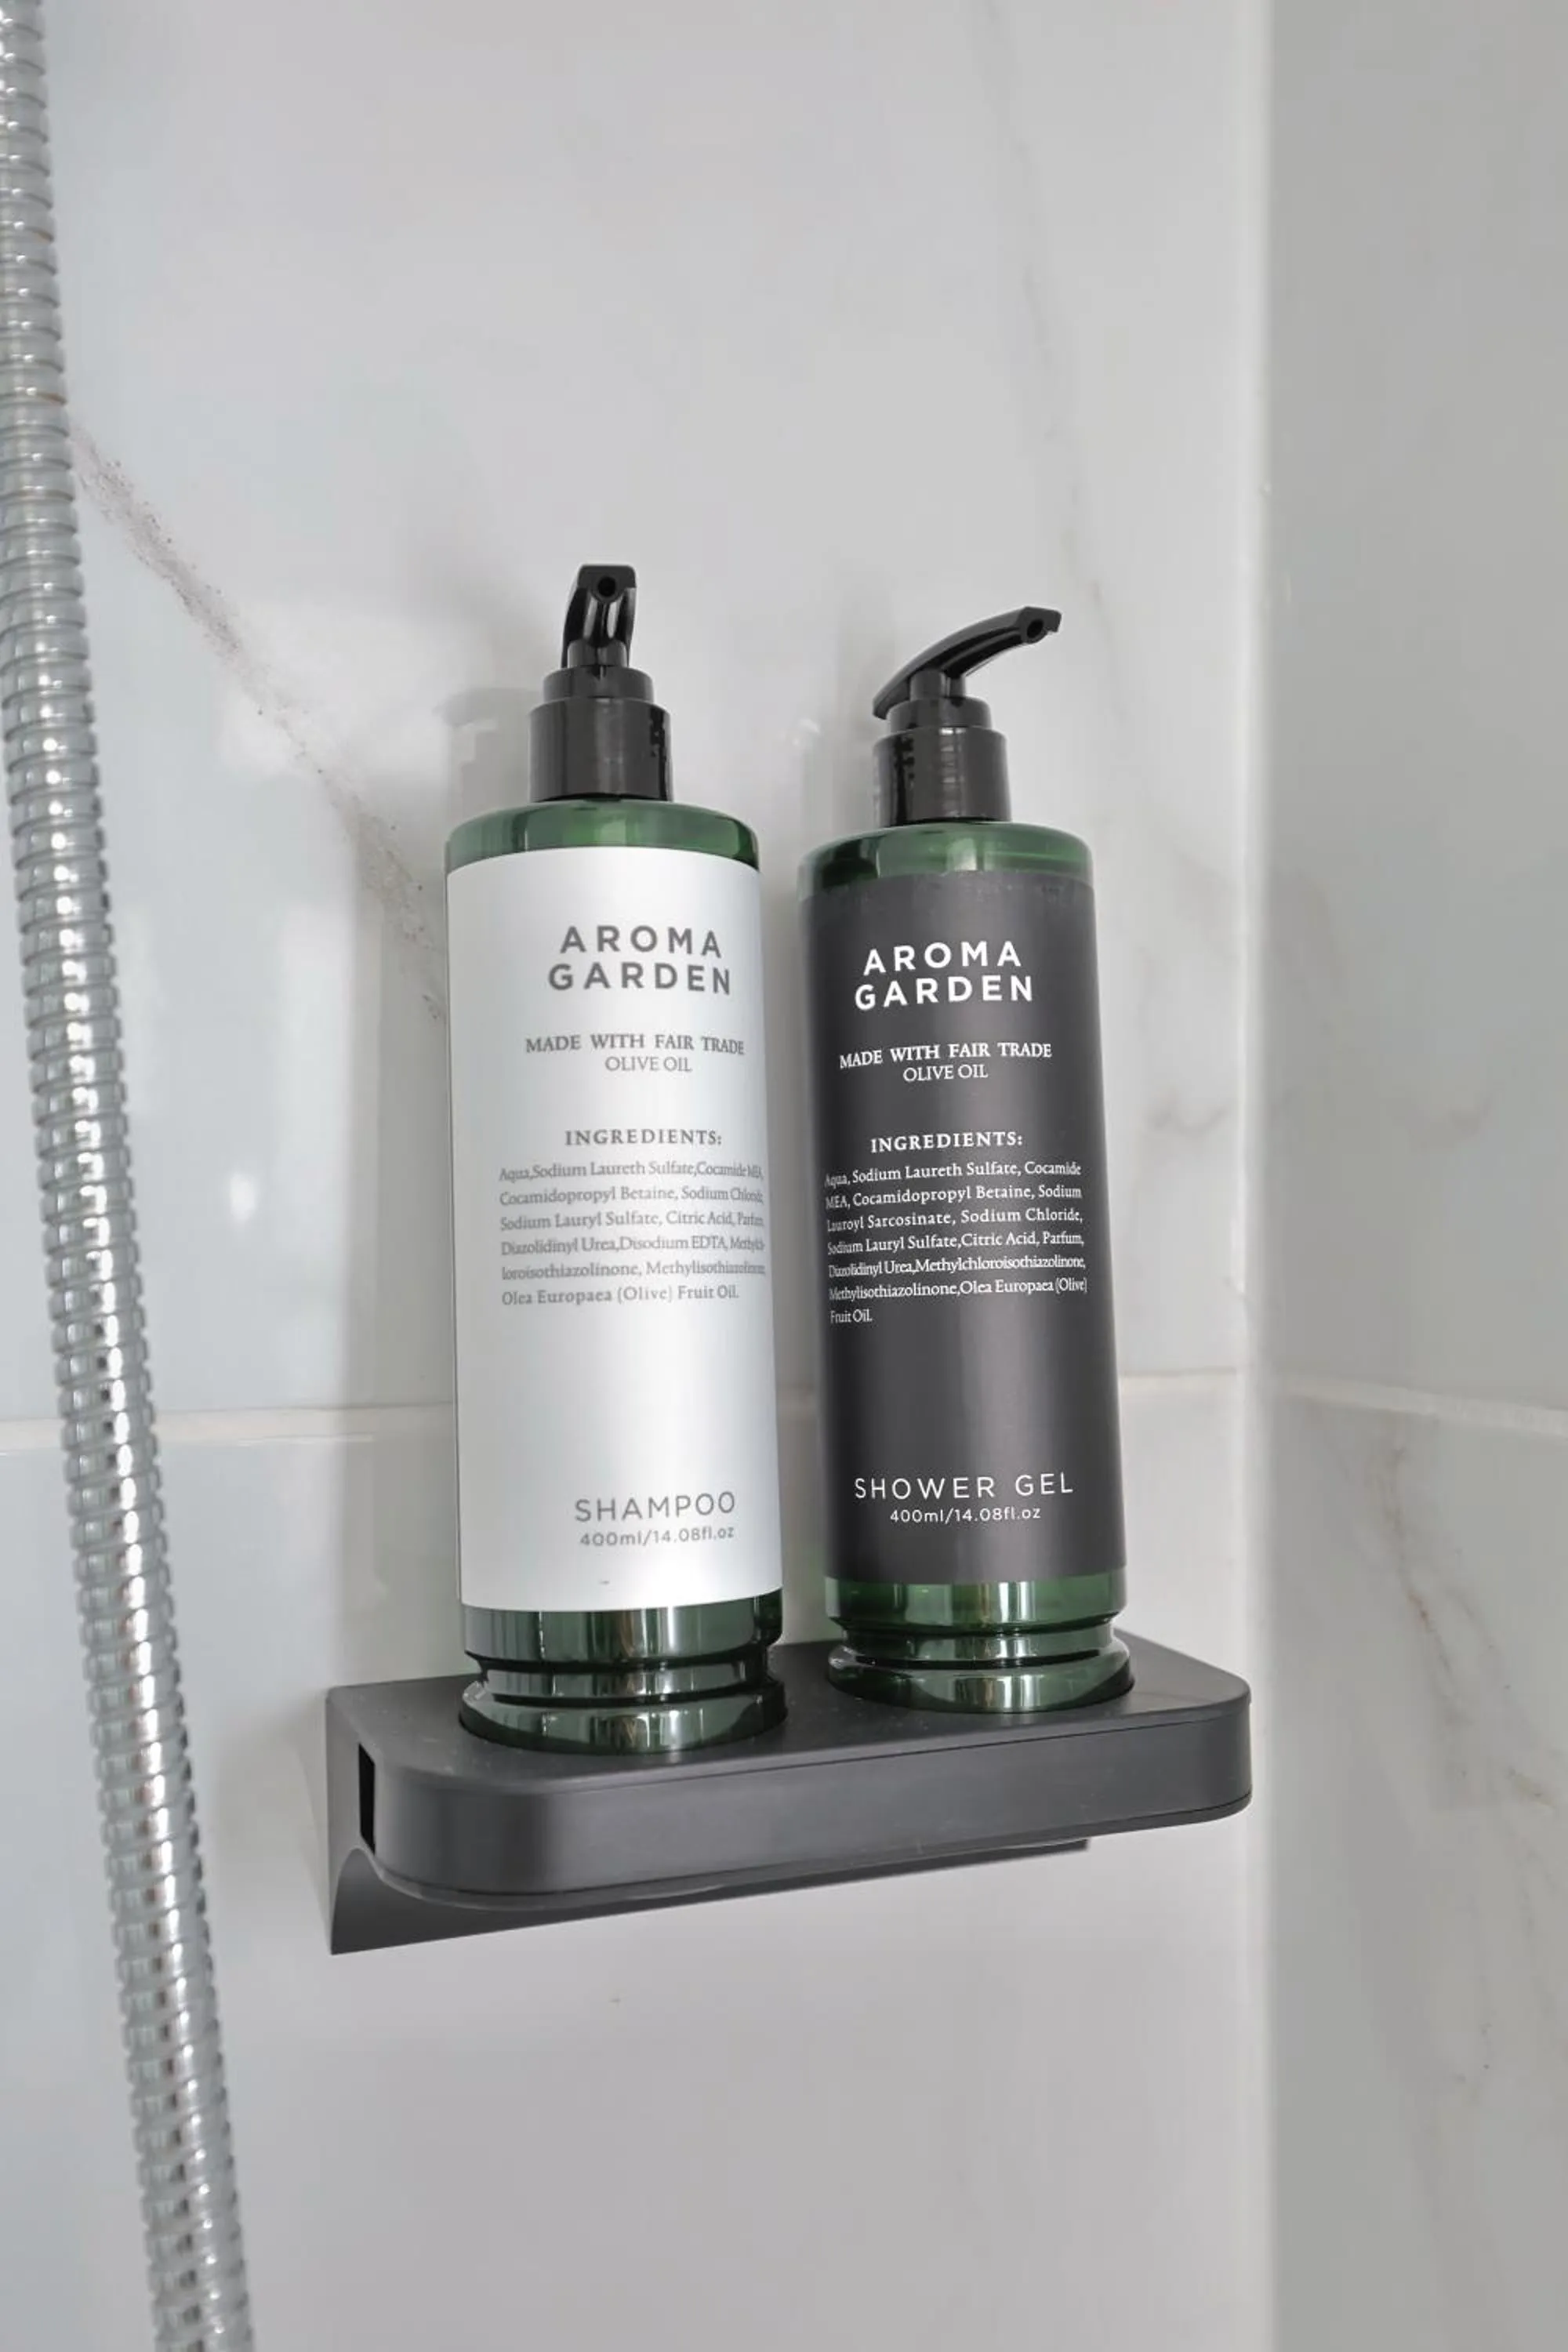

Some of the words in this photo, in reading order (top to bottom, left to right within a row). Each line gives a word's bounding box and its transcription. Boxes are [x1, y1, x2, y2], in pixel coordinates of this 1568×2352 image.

[560, 925, 721, 959] AROMA
[863, 941, 1021, 976] AROMA
[548, 961, 730, 996] GARDEN
[855, 975, 1033, 1011] GARDEN
[526, 1035, 581, 1054] MADE
[590, 1034, 644, 1049] WITH
[655, 1034, 695, 1051] FAIR
[701, 1036, 745, 1055] TRADE
[605, 1056, 659, 1072] OLIVE
[663, 1056, 692, 1072] OIL
[840, 1051, 883, 1069] MADE
[890, 1045, 940, 1063] WITH
[948, 1043, 991, 1058] FAIR
[997, 1043, 1052, 1058] TRADE
[903, 1065, 953, 1083] OLIVE
[957, 1065, 988, 1080] OIL
[564, 1129, 722, 1146] INGREDIENTS:
[870, 1131, 1023, 1153] INGREDIENTS:
[590, 1160, 645, 1176] Laureth
[825, 1173, 851, 1188] Aqua,
[852, 1169, 901, 1185] Sodium
[906, 1164, 963, 1179] Laureth
[966, 1161, 1022, 1178] Sulfate,
[1025, 1160, 1081, 1175] Cocamide
[621, 1186, 678, 1200] Betaine,
[681, 1185, 729, 1200] Sodium
[826, 1195, 851, 1210] MEA,
[852, 1186, 971, 1207] Cocamidopropyl
[976, 1185, 1035, 1201] Betaine,
[1038, 1184, 1082, 1200] Sodium
[555, 1213, 602, 1229] Lauryl
[605, 1210, 663, 1227] Sulfate,
[827, 1217, 864, 1233] Lauroyl
[868, 1212, 956, 1229] Sarcosinate,
[960, 1209, 1022, 1224] Sodium
[1025, 1207, 1083, 1223] Chloride,
[828, 1240, 863, 1255] Sodium
[866, 1237, 905, 1254] Lauryl
[1006, 1231, 1040, 1248] Acid,
[1043, 1230, 1084, 1247] Parfum,
[502, 1290, 532, 1305] Olea
[536, 1288, 612, 1306] Europaea
[617, 1287, 673, 1305] (Olive)
[677, 1286, 714, 1300] Fruit
[995, 1278, 1054, 1295] Europaea
[830, 1310, 851, 1323] Fruit
[852, 1308, 873, 1323] Oil.
[855, 1475, 996, 1500] SHOWER
[1014, 1472, 1074, 1497] GEL
[575, 1491, 735, 1523] SHAMPOO
[890, 1505, 1041, 1524] 400ml/14.08fl.oz
[579, 1525, 735, 1547] 400ml/14.08fl.oz
